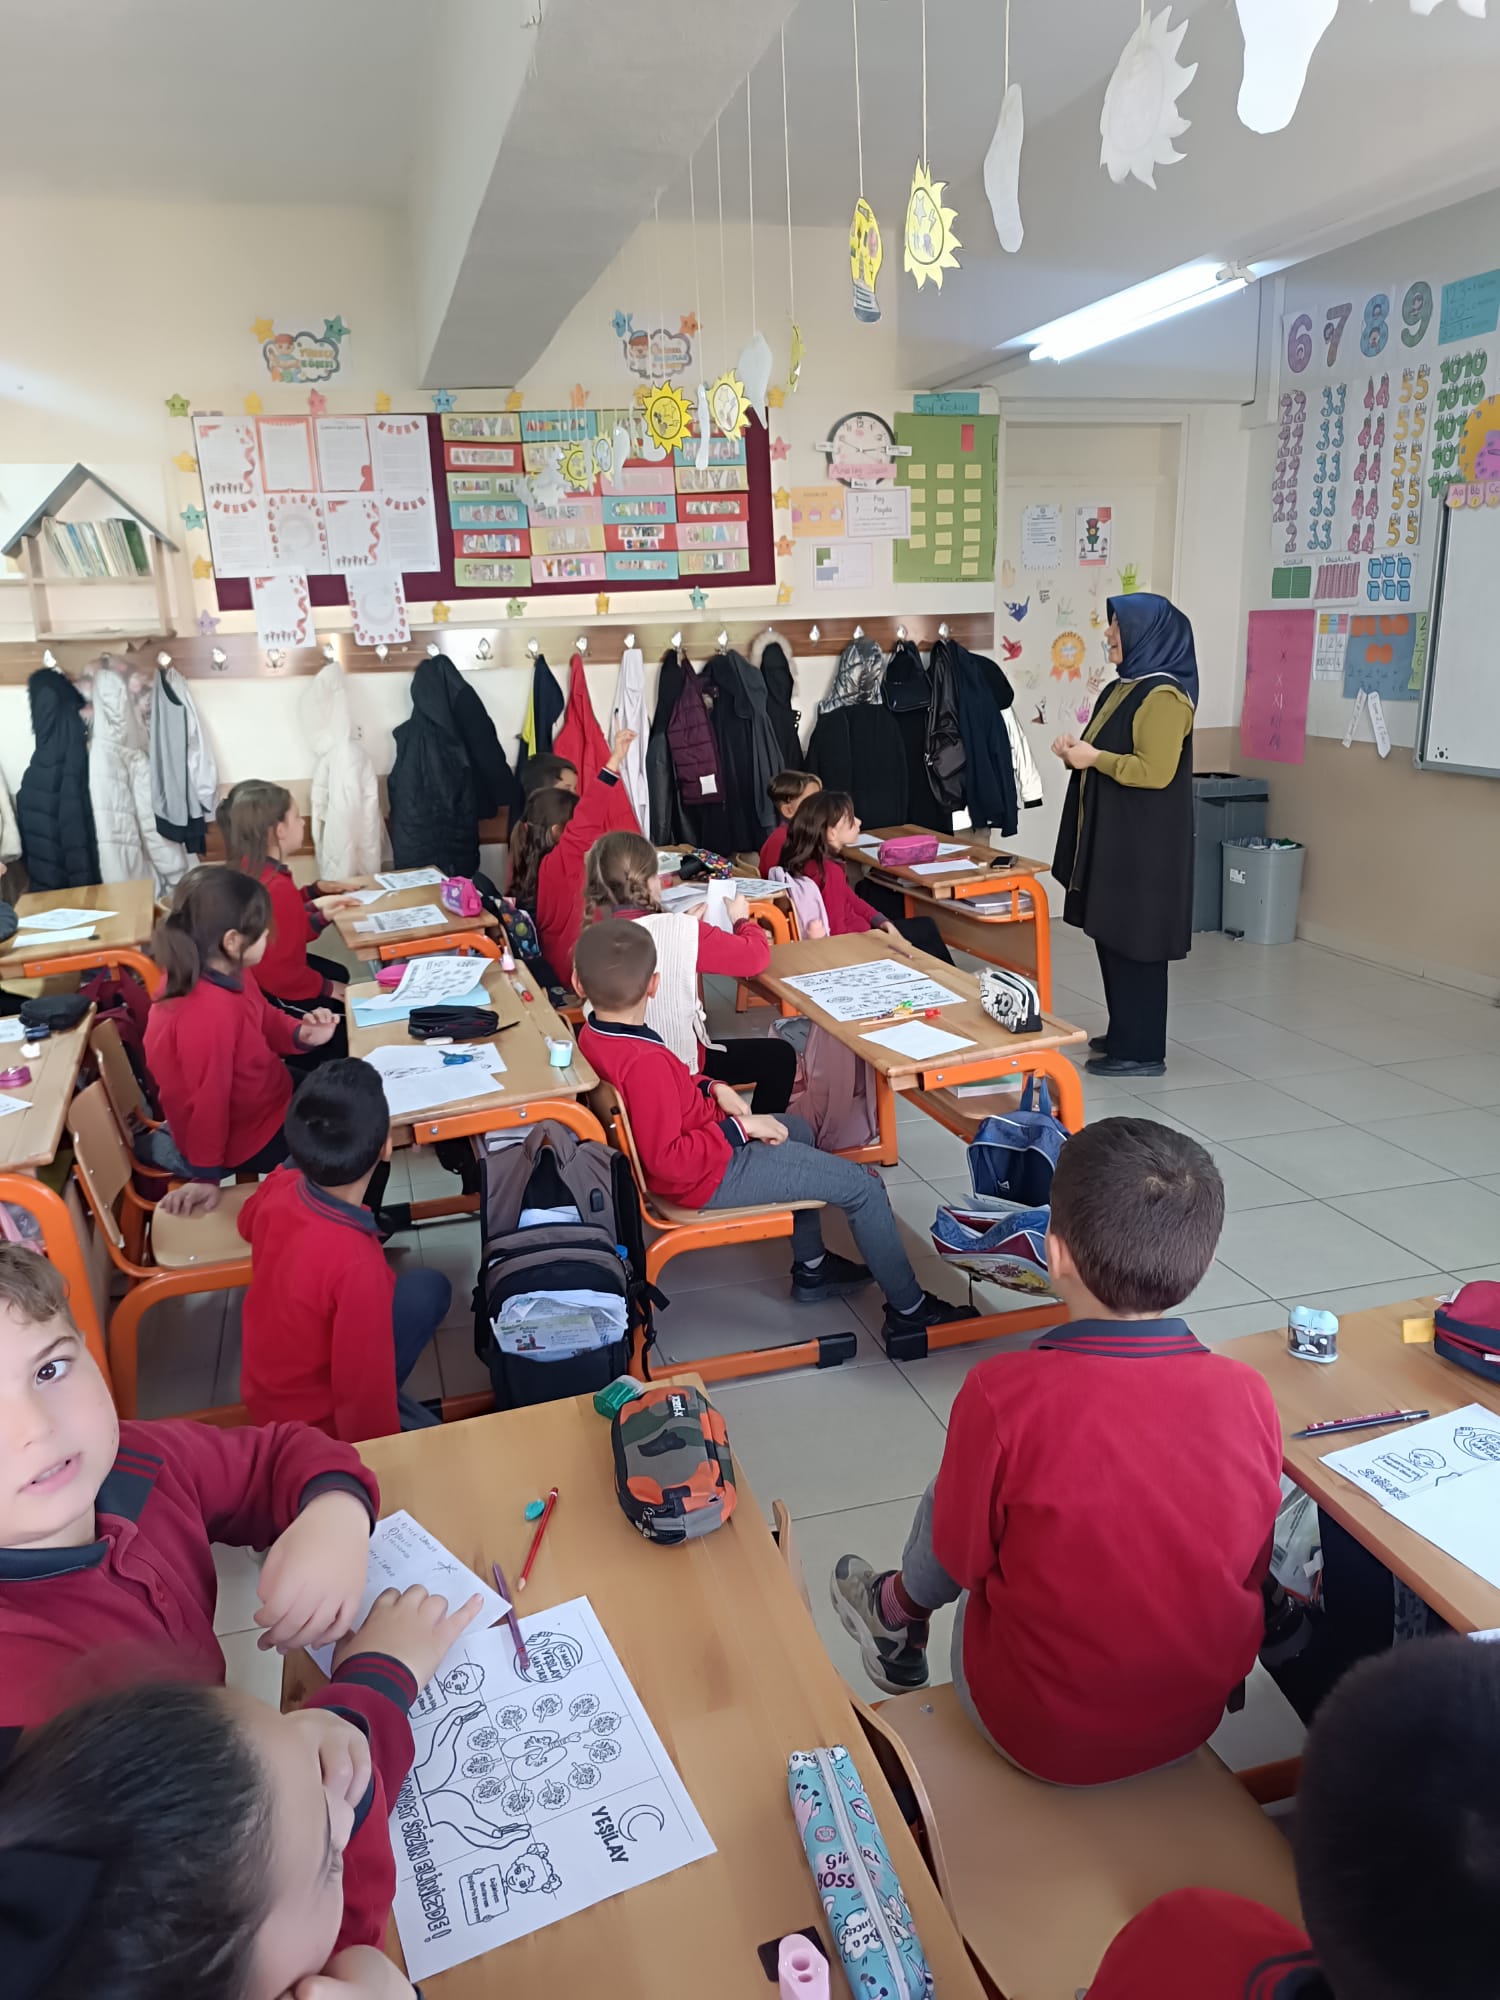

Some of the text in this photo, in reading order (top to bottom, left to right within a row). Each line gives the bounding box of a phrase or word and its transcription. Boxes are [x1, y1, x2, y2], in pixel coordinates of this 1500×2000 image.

[1288, 314, 1312, 373] 6
[1360, 294, 1390, 358] 8
[1401, 281, 1433, 348] 9
[401, 1819, 434, 1862] SİZİN
[591, 1805, 629, 1863] YEŞİLAY
[413, 1858, 451, 1932] ELİNİZDE
